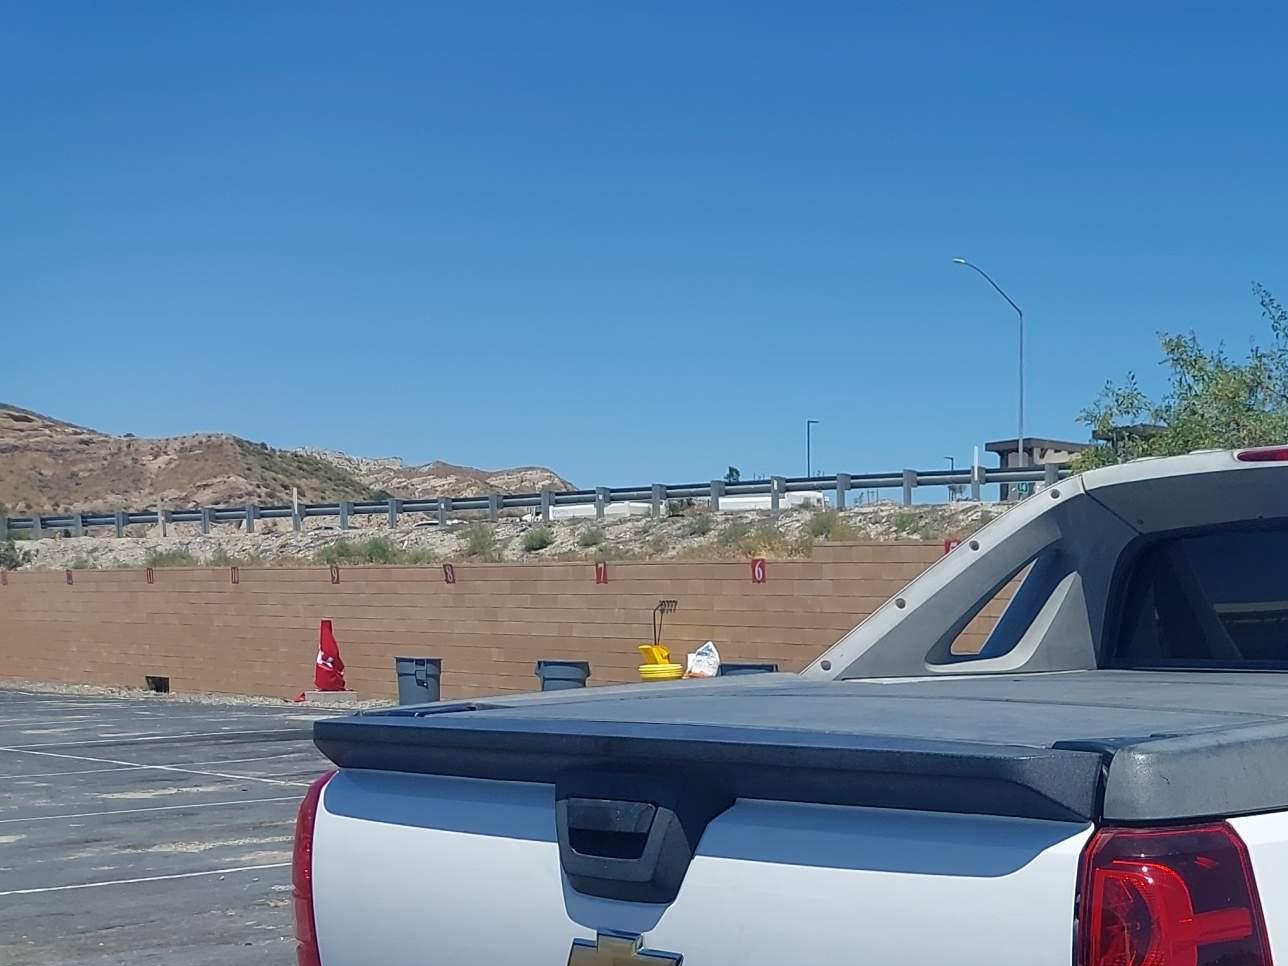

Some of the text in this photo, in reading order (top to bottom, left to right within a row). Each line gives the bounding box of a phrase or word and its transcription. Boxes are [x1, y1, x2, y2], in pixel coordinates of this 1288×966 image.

[331, 567, 338, 583] 9
[445, 565, 453, 582] 8
[754, 560, 763, 581] 6
